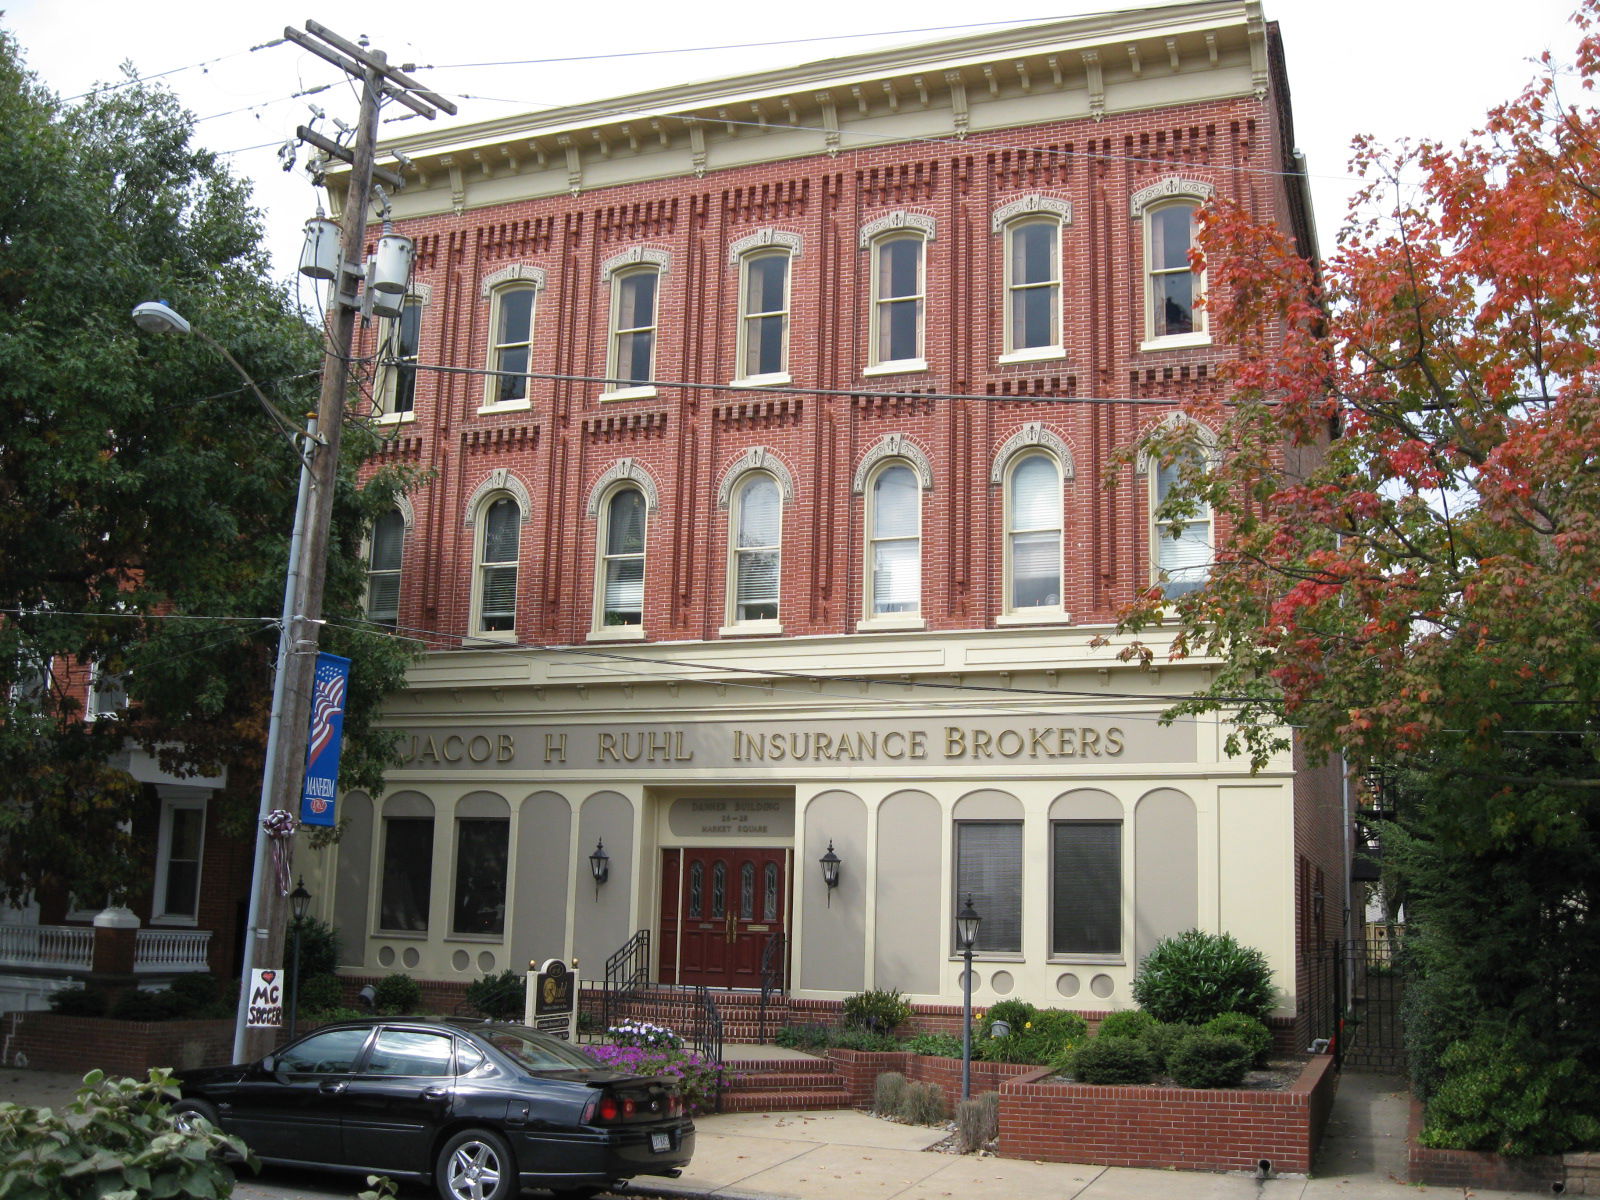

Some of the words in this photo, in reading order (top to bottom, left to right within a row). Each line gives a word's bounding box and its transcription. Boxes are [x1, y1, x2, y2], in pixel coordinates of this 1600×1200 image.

[400, 734, 515, 763] JACOB
[544, 733, 568, 763] H
[597, 730, 694, 762] RUHL
[732, 729, 929, 761] INSURANCE
[943, 726, 1125, 759] BROKERS
[306, 776, 335, 797] MANHEIM
[734, 802, 780, 812] BUILDING
[701, 825, 732, 833] MARKET
[738, 825, 768, 833] SQUARE
[252, 985, 279, 1005] MC
[248, 1006, 282, 1025] SOCCER
